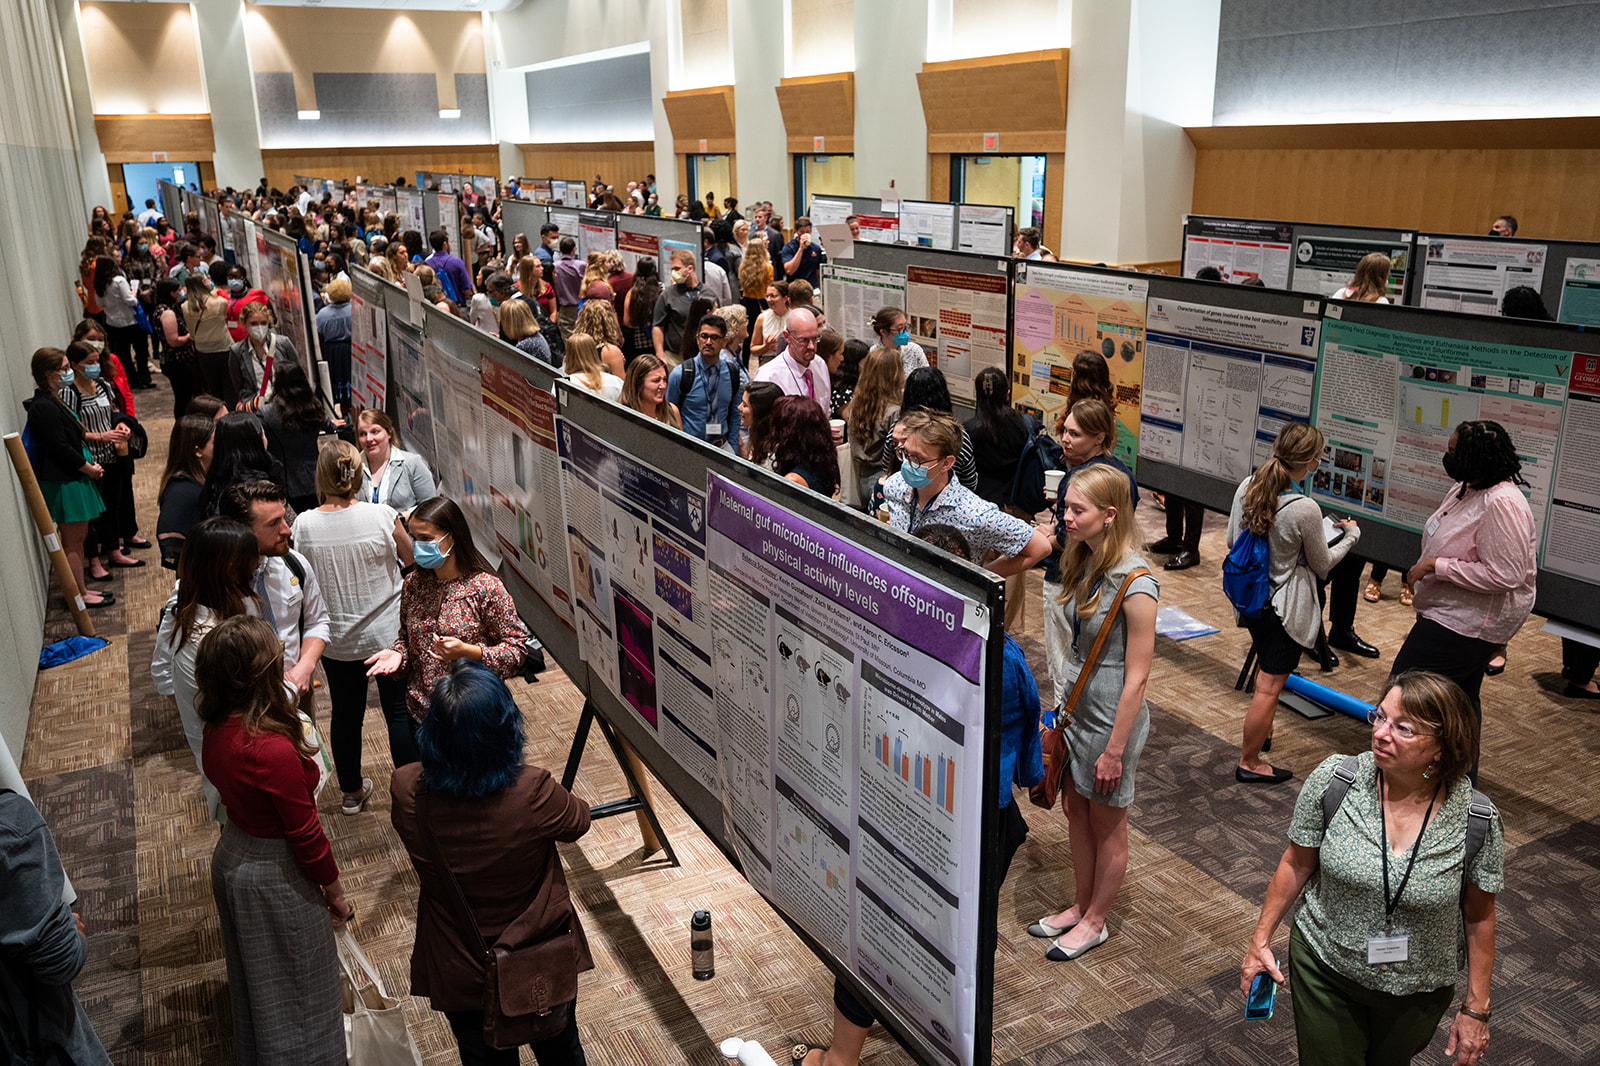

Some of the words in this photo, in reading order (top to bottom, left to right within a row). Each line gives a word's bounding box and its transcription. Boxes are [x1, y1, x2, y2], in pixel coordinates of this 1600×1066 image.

[1261, 317, 1282, 326] specificity
[1391, 333, 1422, 344] Techniques
[1435, 340, 1469, 350] Euthanasia
[1471, 345, 1500, 354] Methods
[1524, 350, 1557, 360] Detection
[1564, 501, 1583, 509] Materials
[720, 489, 753, 521] Maternal
[755, 513, 770, 531] gut
[772, 522, 825, 560] microbiota
[828, 548, 887, 593] influences
[891, 585, 955, 631] offspring
[762, 540, 801, 571] physical
[804, 564, 842, 597] activity
[845, 582, 879, 615] levels
[815, 596, 826, 609] Zach
[853, 618, 861, 630] and
[862, 624, 876, 639] Aaron
[878, 633, 882, 643] C.
[975, 606, 985, 618] 57
[893, 666, 918, 684] Columbia
[917, 680, 927, 690] MO
[893, 690, 906, 702] Driven
[935, 710, 946, 723] Males
